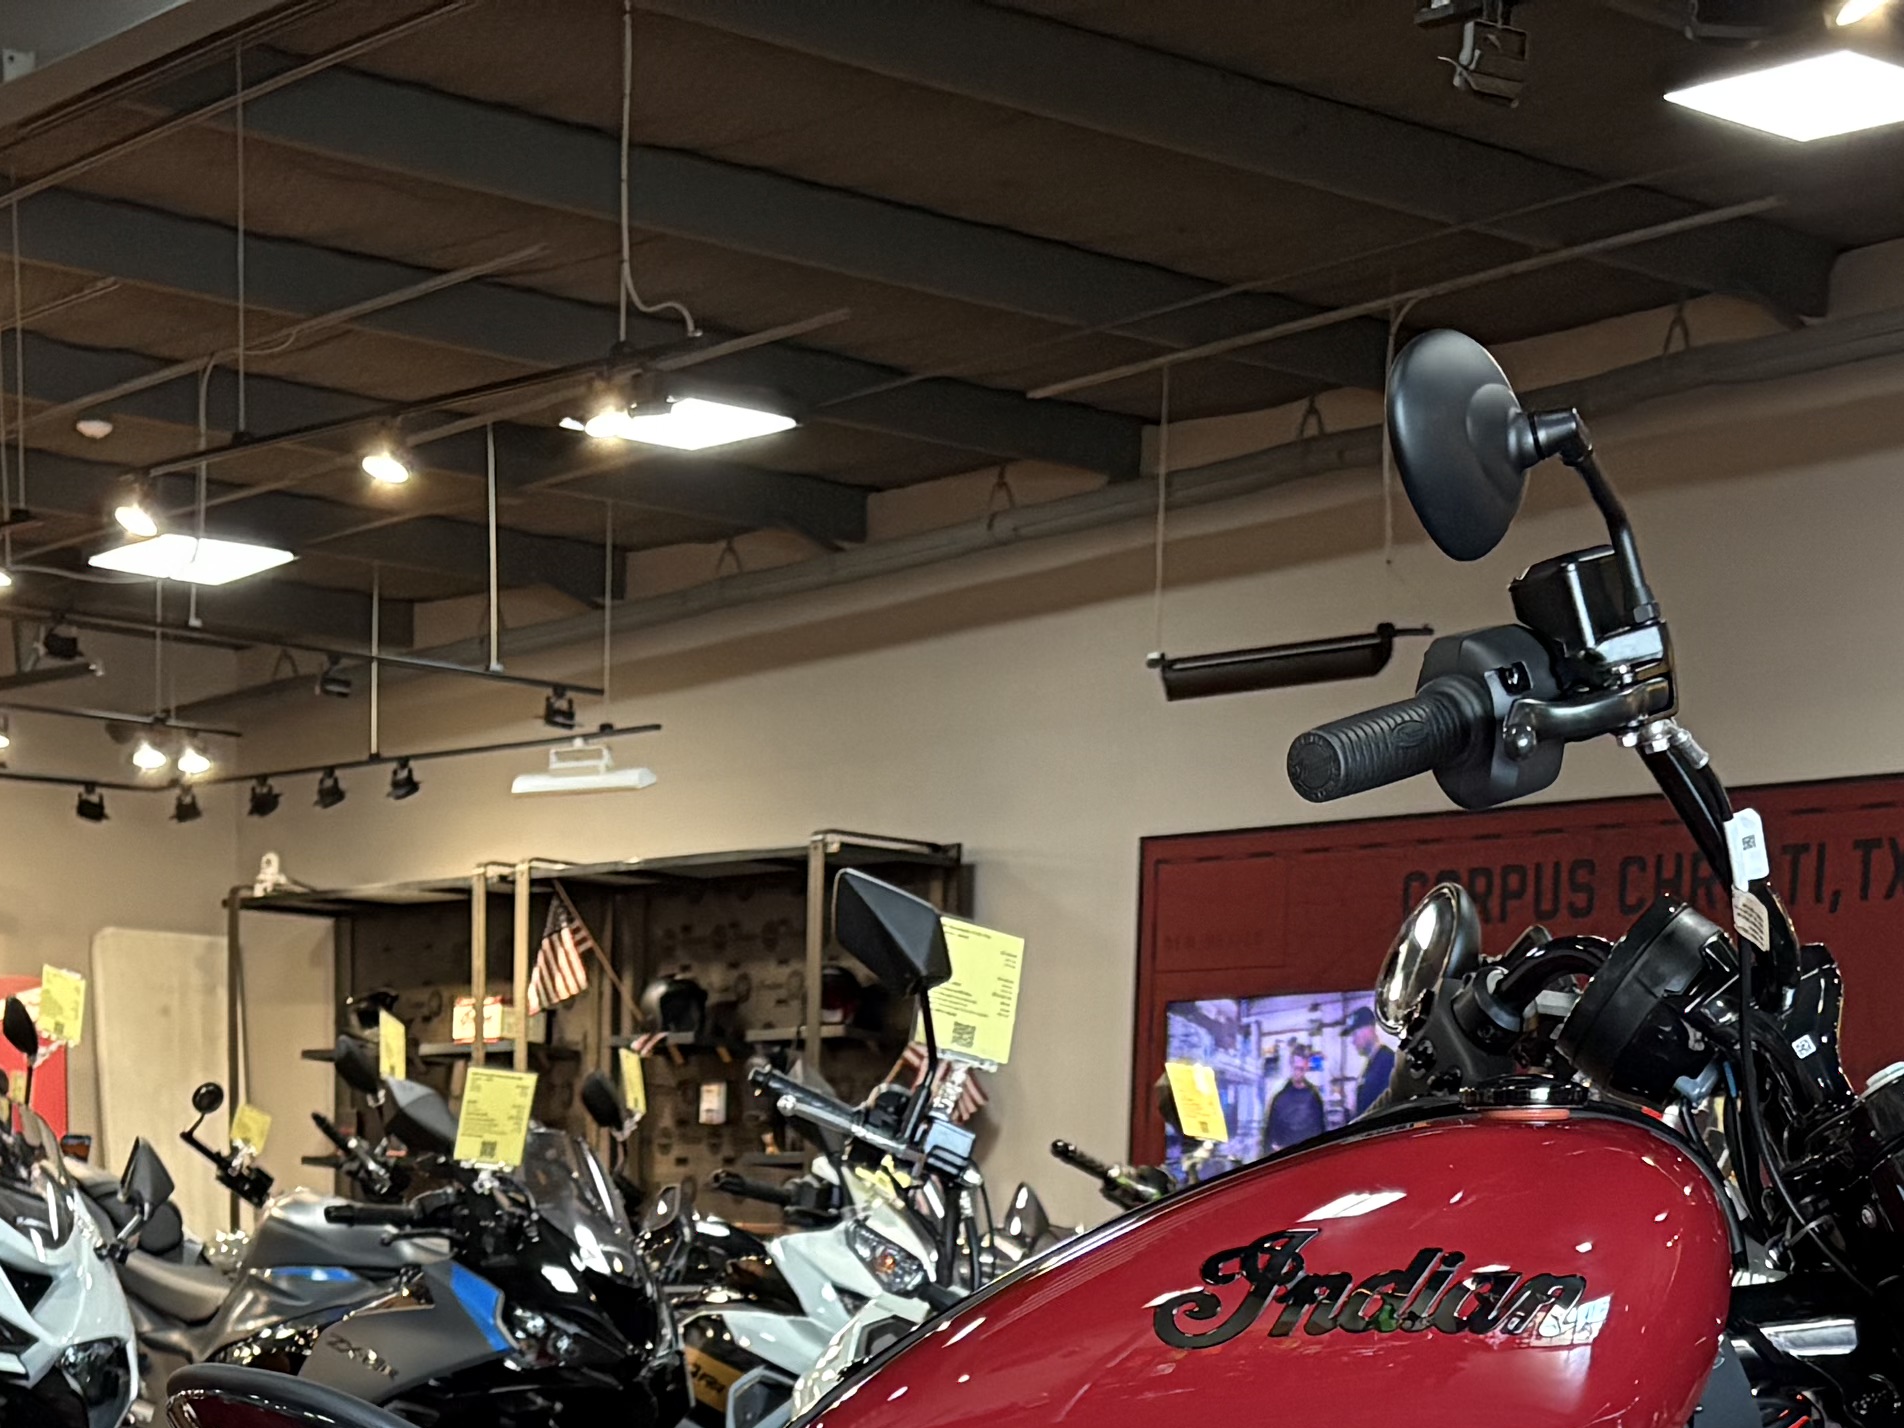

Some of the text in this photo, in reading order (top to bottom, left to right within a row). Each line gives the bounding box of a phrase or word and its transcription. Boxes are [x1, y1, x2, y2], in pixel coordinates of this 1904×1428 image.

[1403, 858, 1596, 924] CRPUS
[1617, 838, 1843, 915] CHRTI,
[1153, 1228, 1588, 1350] Indian
